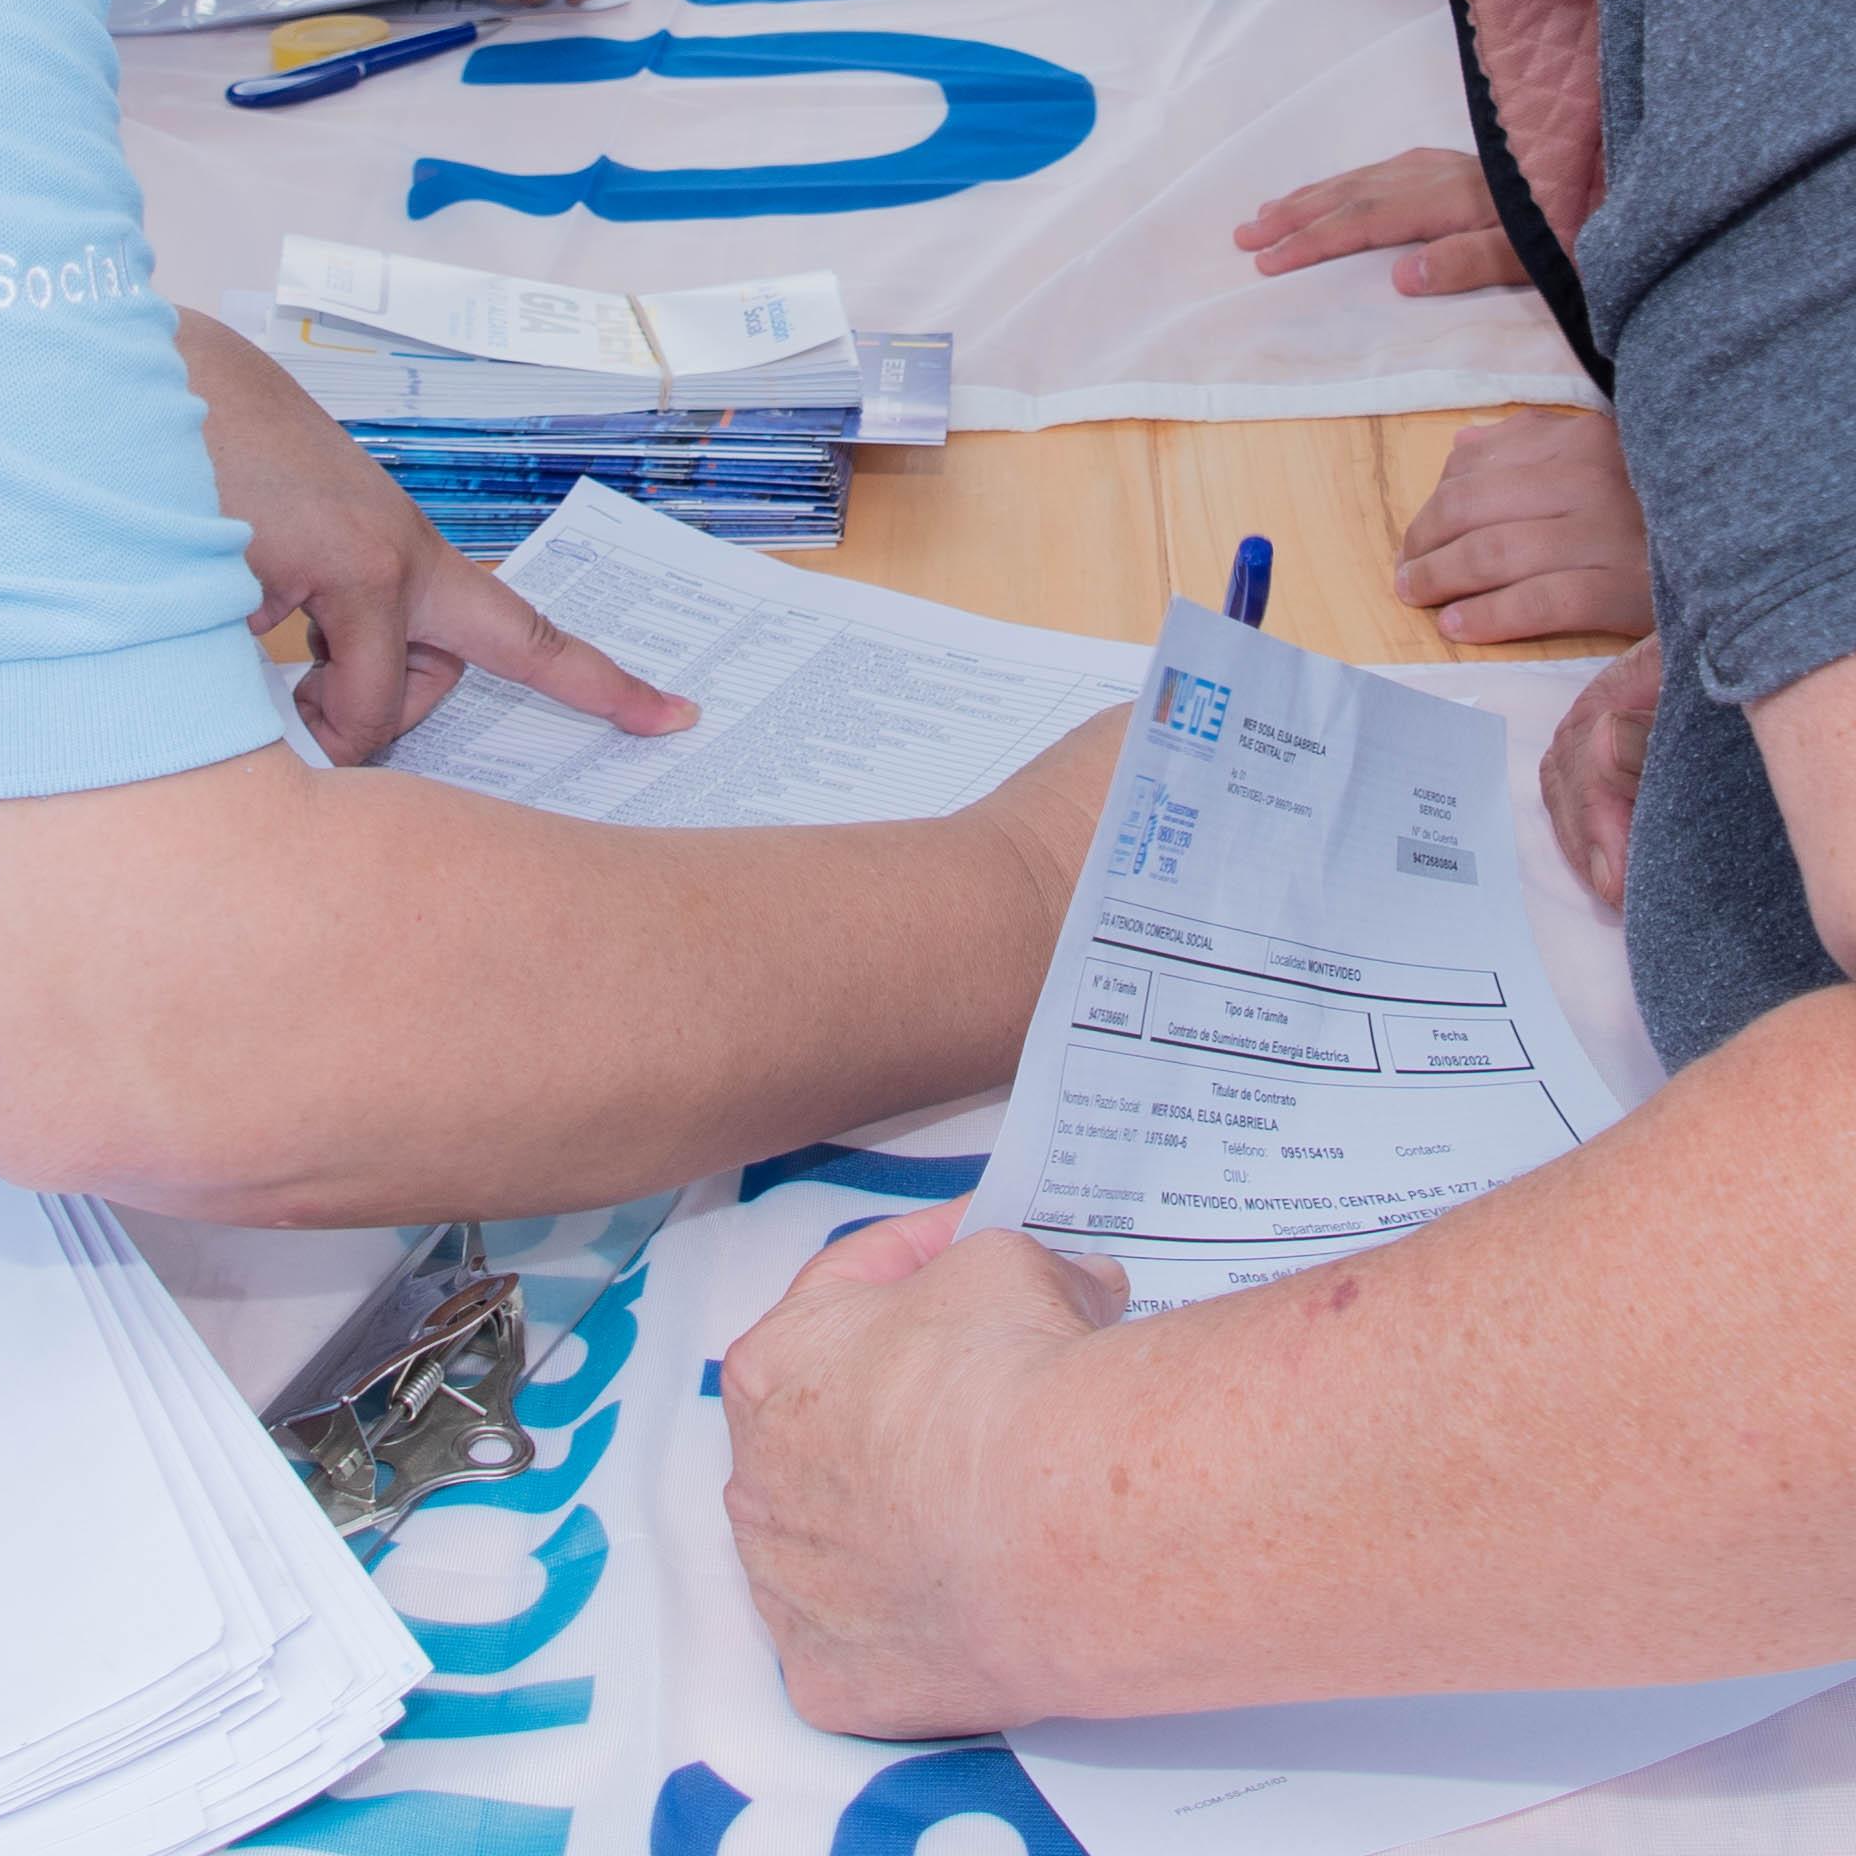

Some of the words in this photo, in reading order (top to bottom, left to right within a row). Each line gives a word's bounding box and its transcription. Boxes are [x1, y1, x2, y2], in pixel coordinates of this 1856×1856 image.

[1418, 803, 1452, 821] SERVICIO
[1432, 829, 1458, 846] Cuenta
[1144, 921, 1186, 946] COMERCIAL
[1185, 932, 1214, 951] SOCIAL
[1307, 958, 1362, 982] MONTEVIDEO
[1111, 977, 1137, 996] Trámite
[1224, 1000, 1243, 1019] Tipo
[1243, 1006, 1254, 1019] de
[1256, 1006, 1289, 1026] Trámite
[1167, 1021, 1198, 1040] Contrato
[1199, 1028, 1211, 1042] de
[1211, 1029, 1258, 1051] Suministro
[1258, 1039, 1270, 1053] de
[1271, 1040, 1304, 1060] Energía
[1305, 1045, 1351, 1064] Eléctrica
[1431, 1029, 1469, 1043] Fecha
[1426, 1054, 1492, 1067] 20/08/2022
[1211, 1082, 1239, 1099] Titular
[1240, 1087, 1252, 1101] de
[1253, 1088, 1297, 1106] Contrato
[1197, 1107, 1223, 1125] ELSA
[1224, 1112, 1280, 1132] GABRIELA
[1221, 1140, 1269, 1158] Teléfono:
[1280, 1146, 1345, 1160] 095154159
[1160, 1190, 1243, 1212] MONTEVIDEO,
[1244, 1196, 1338, 1211] MONTEVIDEO,
[1339, 1191, 1404, 1208] CENTRAL
[1407, 1185, 1446, 1202] PSJE
[1086, 1212, 1135, 1231] MONTEVIDEO
[1228, 1271, 1269, 1285] Datos
[1123, 1299, 1176, 1314] ENTRAL
